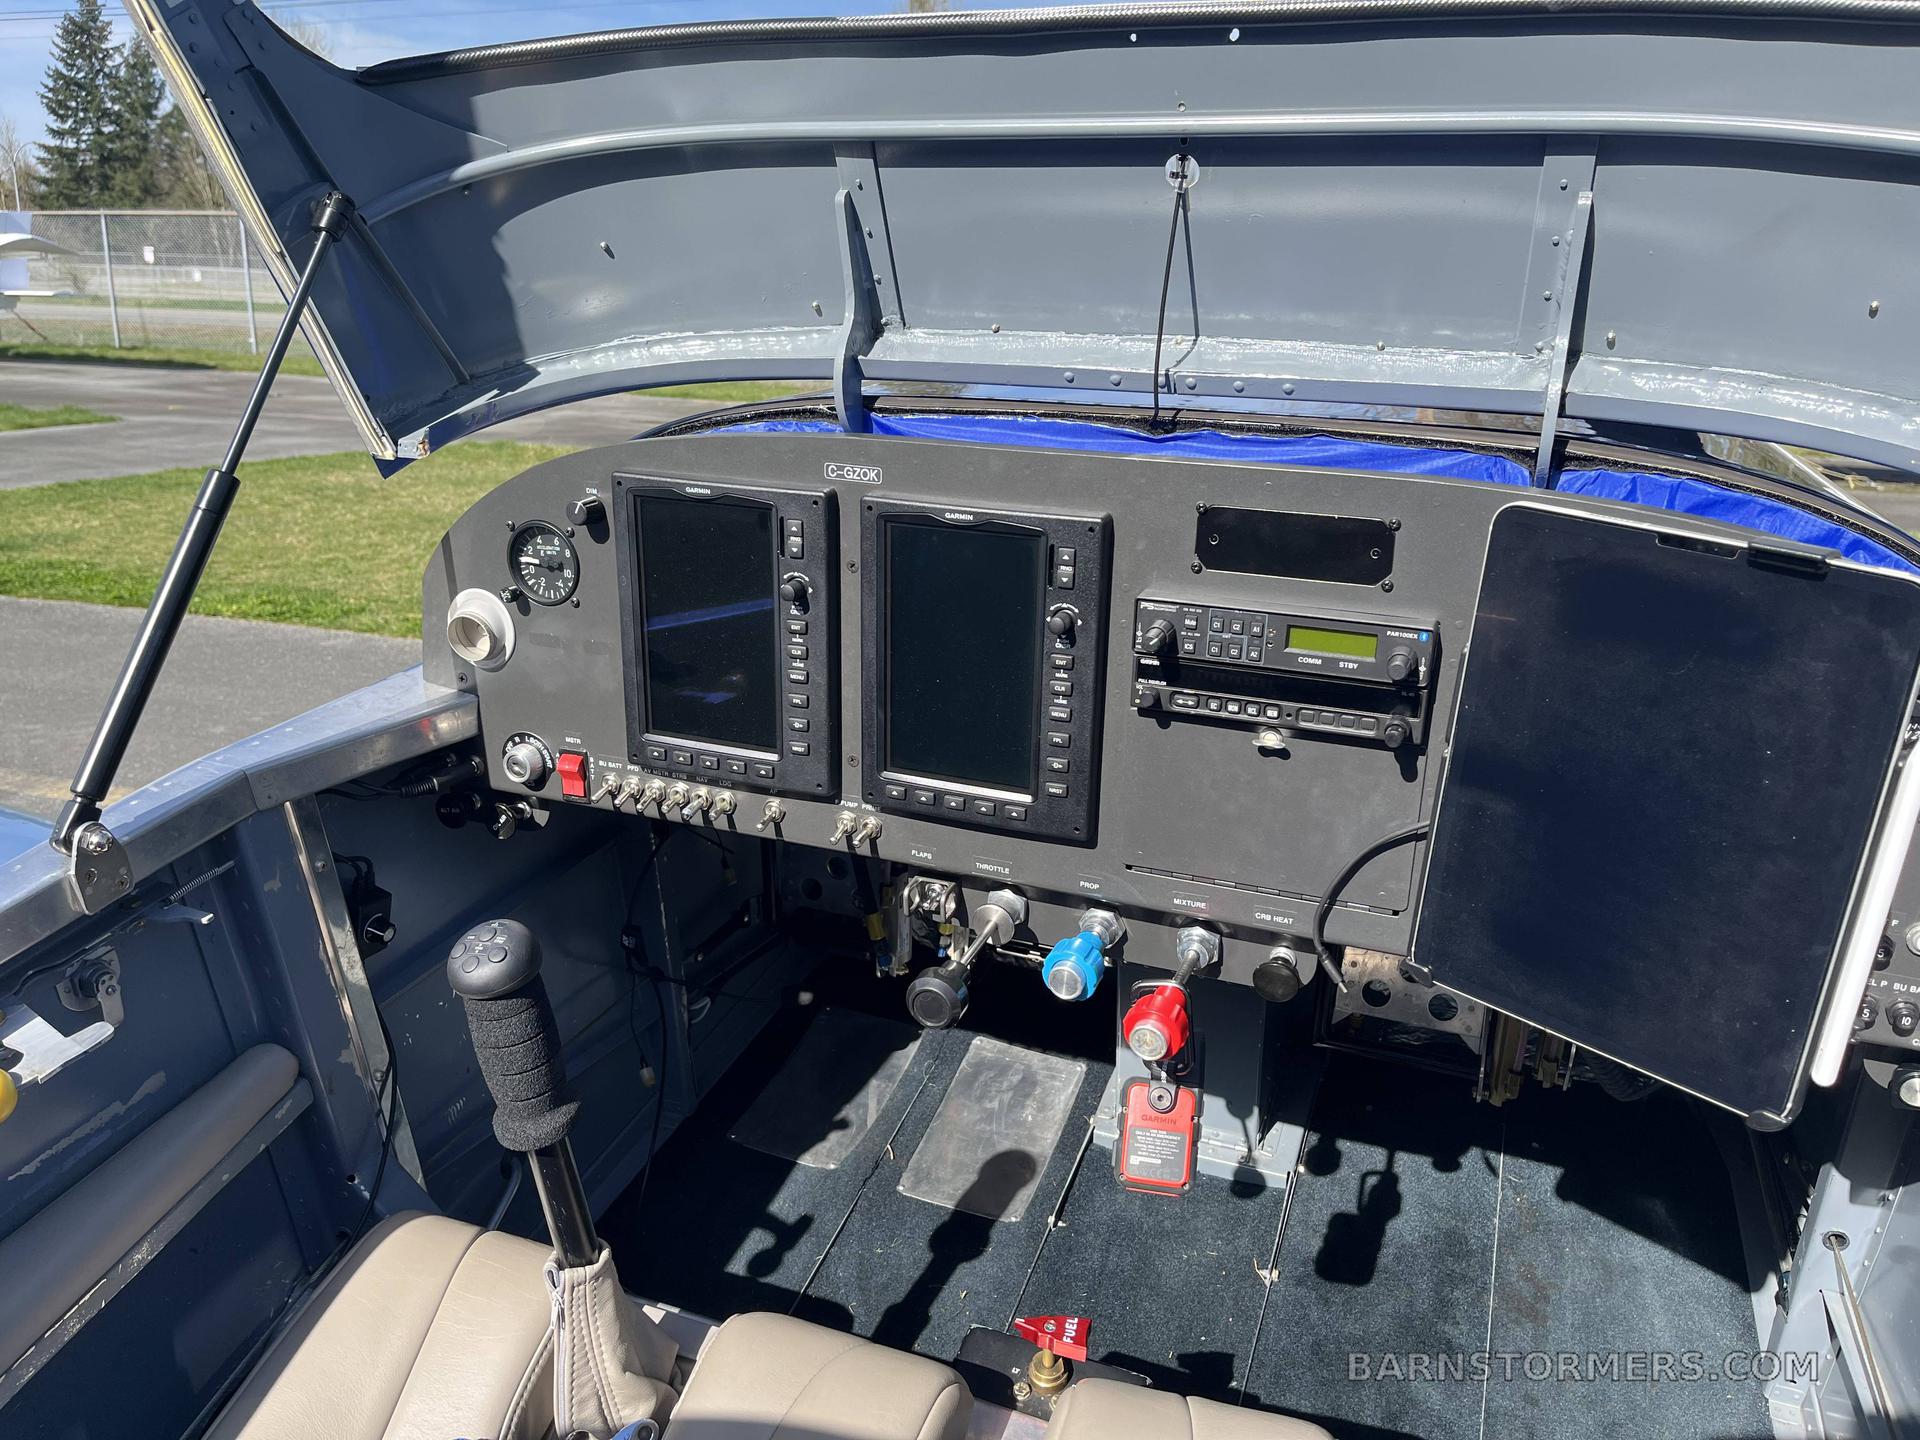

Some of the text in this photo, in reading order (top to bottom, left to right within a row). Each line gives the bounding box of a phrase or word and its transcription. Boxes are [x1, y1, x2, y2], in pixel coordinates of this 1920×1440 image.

[828, 465, 879, 482] C-GZOK
[685, 486, 711, 494] GARMIN
[944, 512, 973, 521] GARMIN
[537, 536, 542, 544] 4
[554, 537, 560, 545] 6
[527, 546, 533, 554] 2
[565, 549, 570, 558] 8
[530, 565, 535, 573] 0
[564, 569, 572, 578] 10
[1184, 618, 1197, 626] Mute
[1386, 630, 1418, 640] PAR100EX
[1298, 656, 1358, 669] COMM STBY
[565, 736, 581, 744] MSTR
[840, 800, 858, 808] PUMP
[911, 850, 933, 860] FLAPS
[976, 862, 1010, 875] THROTTLE
[1079, 880, 1100, 890] PROP
[1173, 898, 1207, 909] MIXTURE
[1255, 912, 1294, 925] CRB HEAT
[1877, 949, 1885, 958] 5
[1893, 982, 1907, 992] BU
[1862, 1008, 1871, 1018] 5
[1901, 1016, 1911, 1026] 10
[1141, 1114, 1177, 1126] GARMIN
[1063, 1317, 1079, 1343] FUEL
